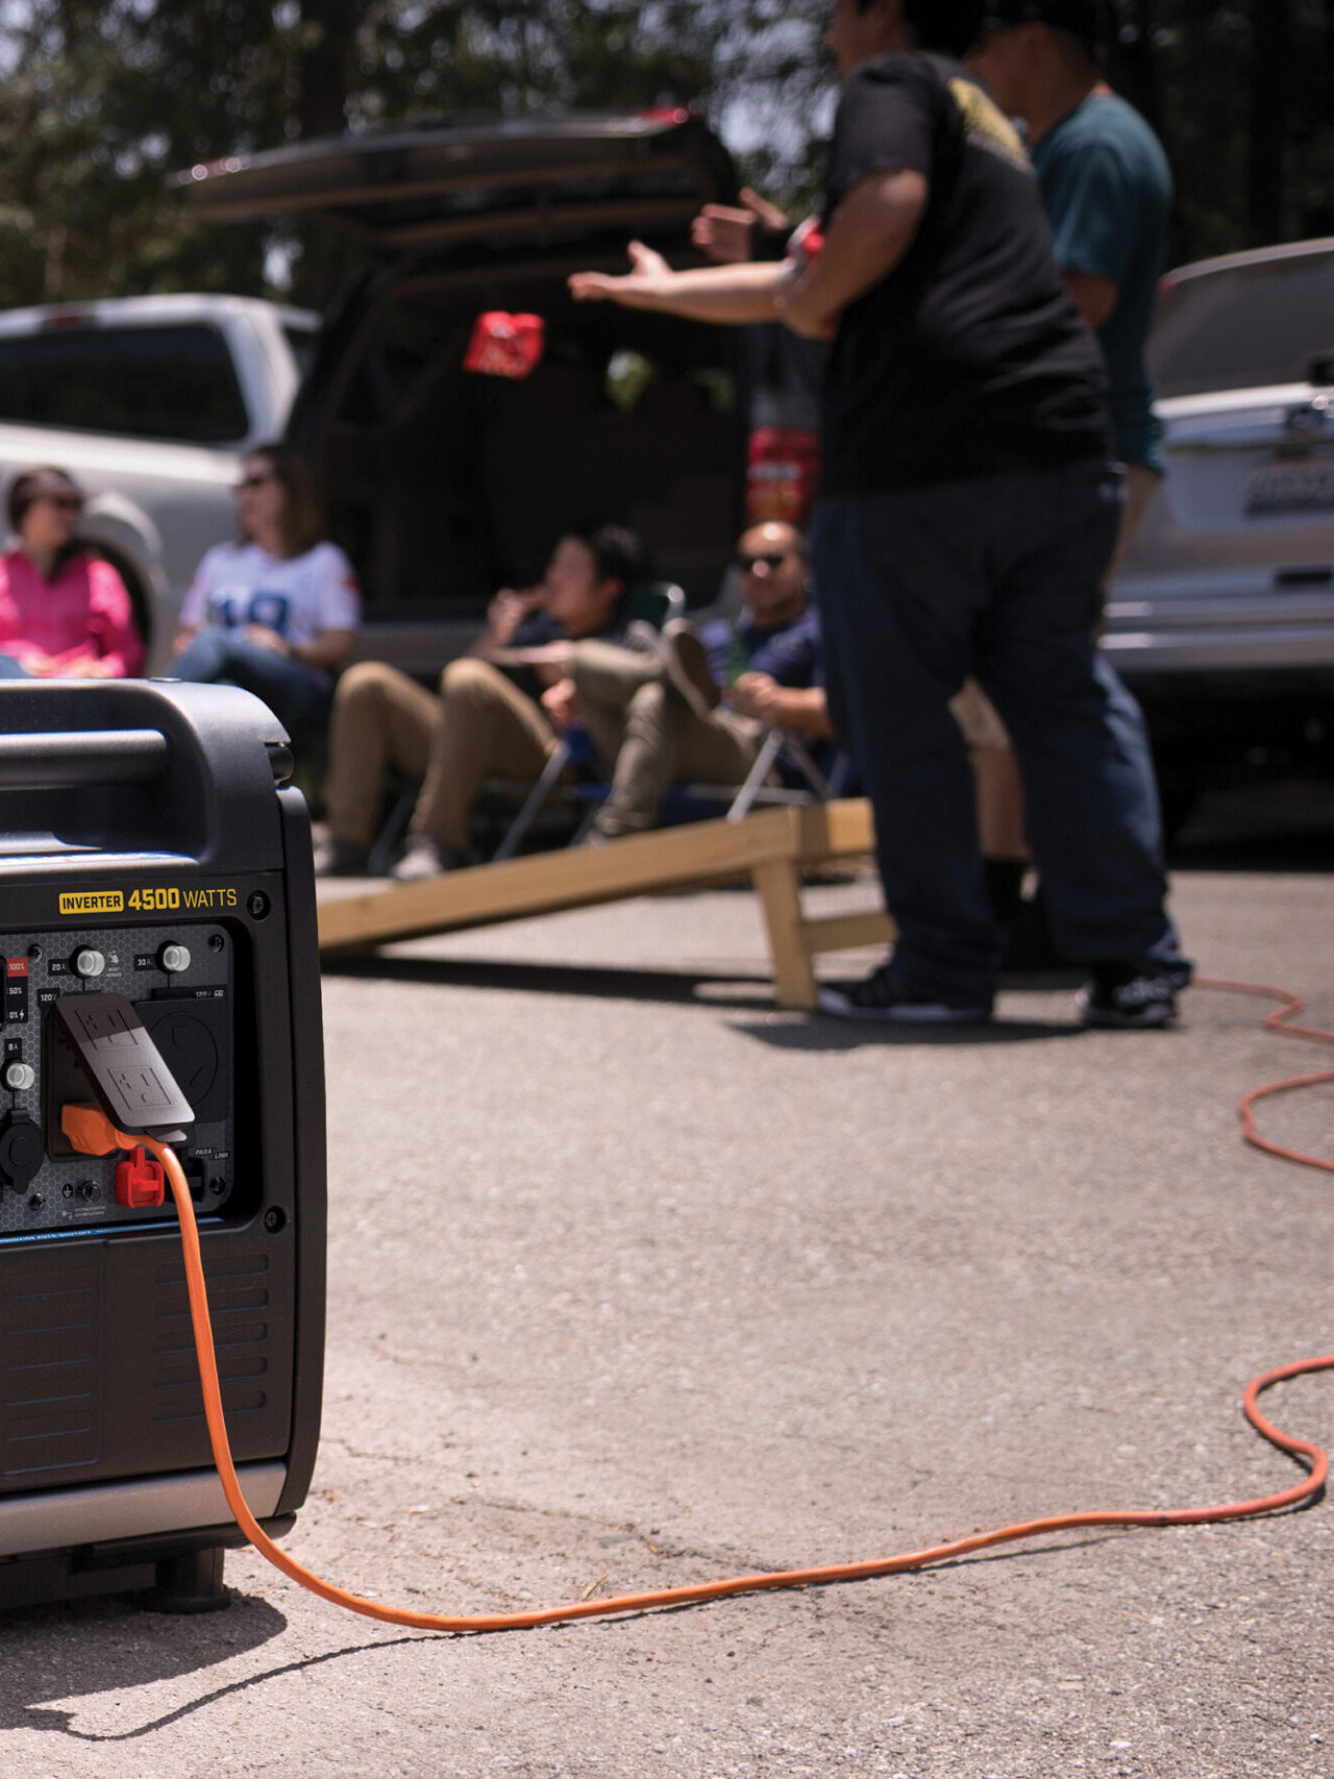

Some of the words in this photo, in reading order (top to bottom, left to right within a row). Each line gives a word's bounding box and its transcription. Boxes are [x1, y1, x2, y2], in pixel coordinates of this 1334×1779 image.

[62, 895, 121, 910] INVERTER
[127, 889, 180, 910] 4500
[183, 889, 237, 908] WATTS
